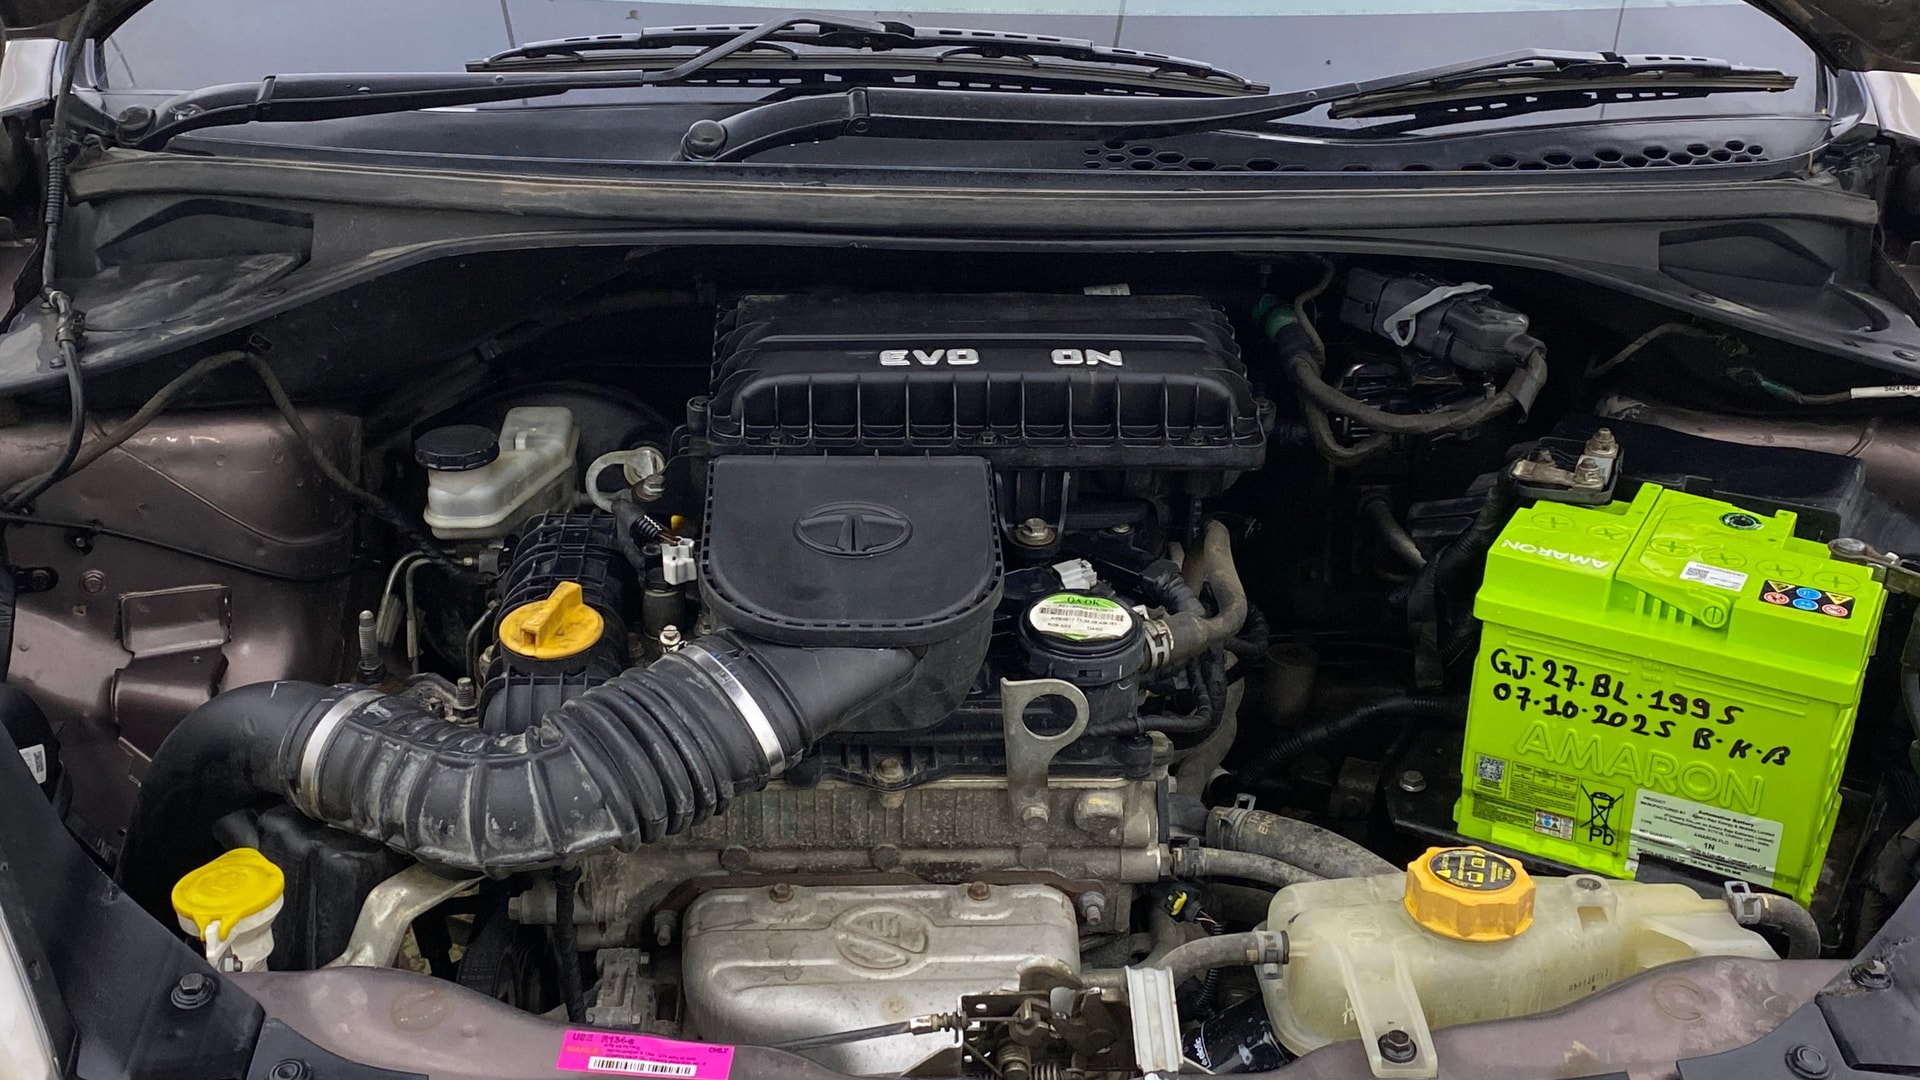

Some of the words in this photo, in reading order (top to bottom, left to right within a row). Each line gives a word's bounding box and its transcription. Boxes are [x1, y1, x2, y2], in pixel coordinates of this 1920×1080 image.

[879, 348, 980, 366] EVO
[1051, 348, 1123, 366] ON
[1500, 538, 1609, 569] AMARON
[1515, 719, 1764, 816] AMARON
[1698, 809, 1731, 821] Automotive
[1732, 818, 1754, 828] Battery
[1588, 826, 1615, 847] Pb
[1694, 833, 1717, 842] AMARON
[1704, 842, 1715, 850] 1N
